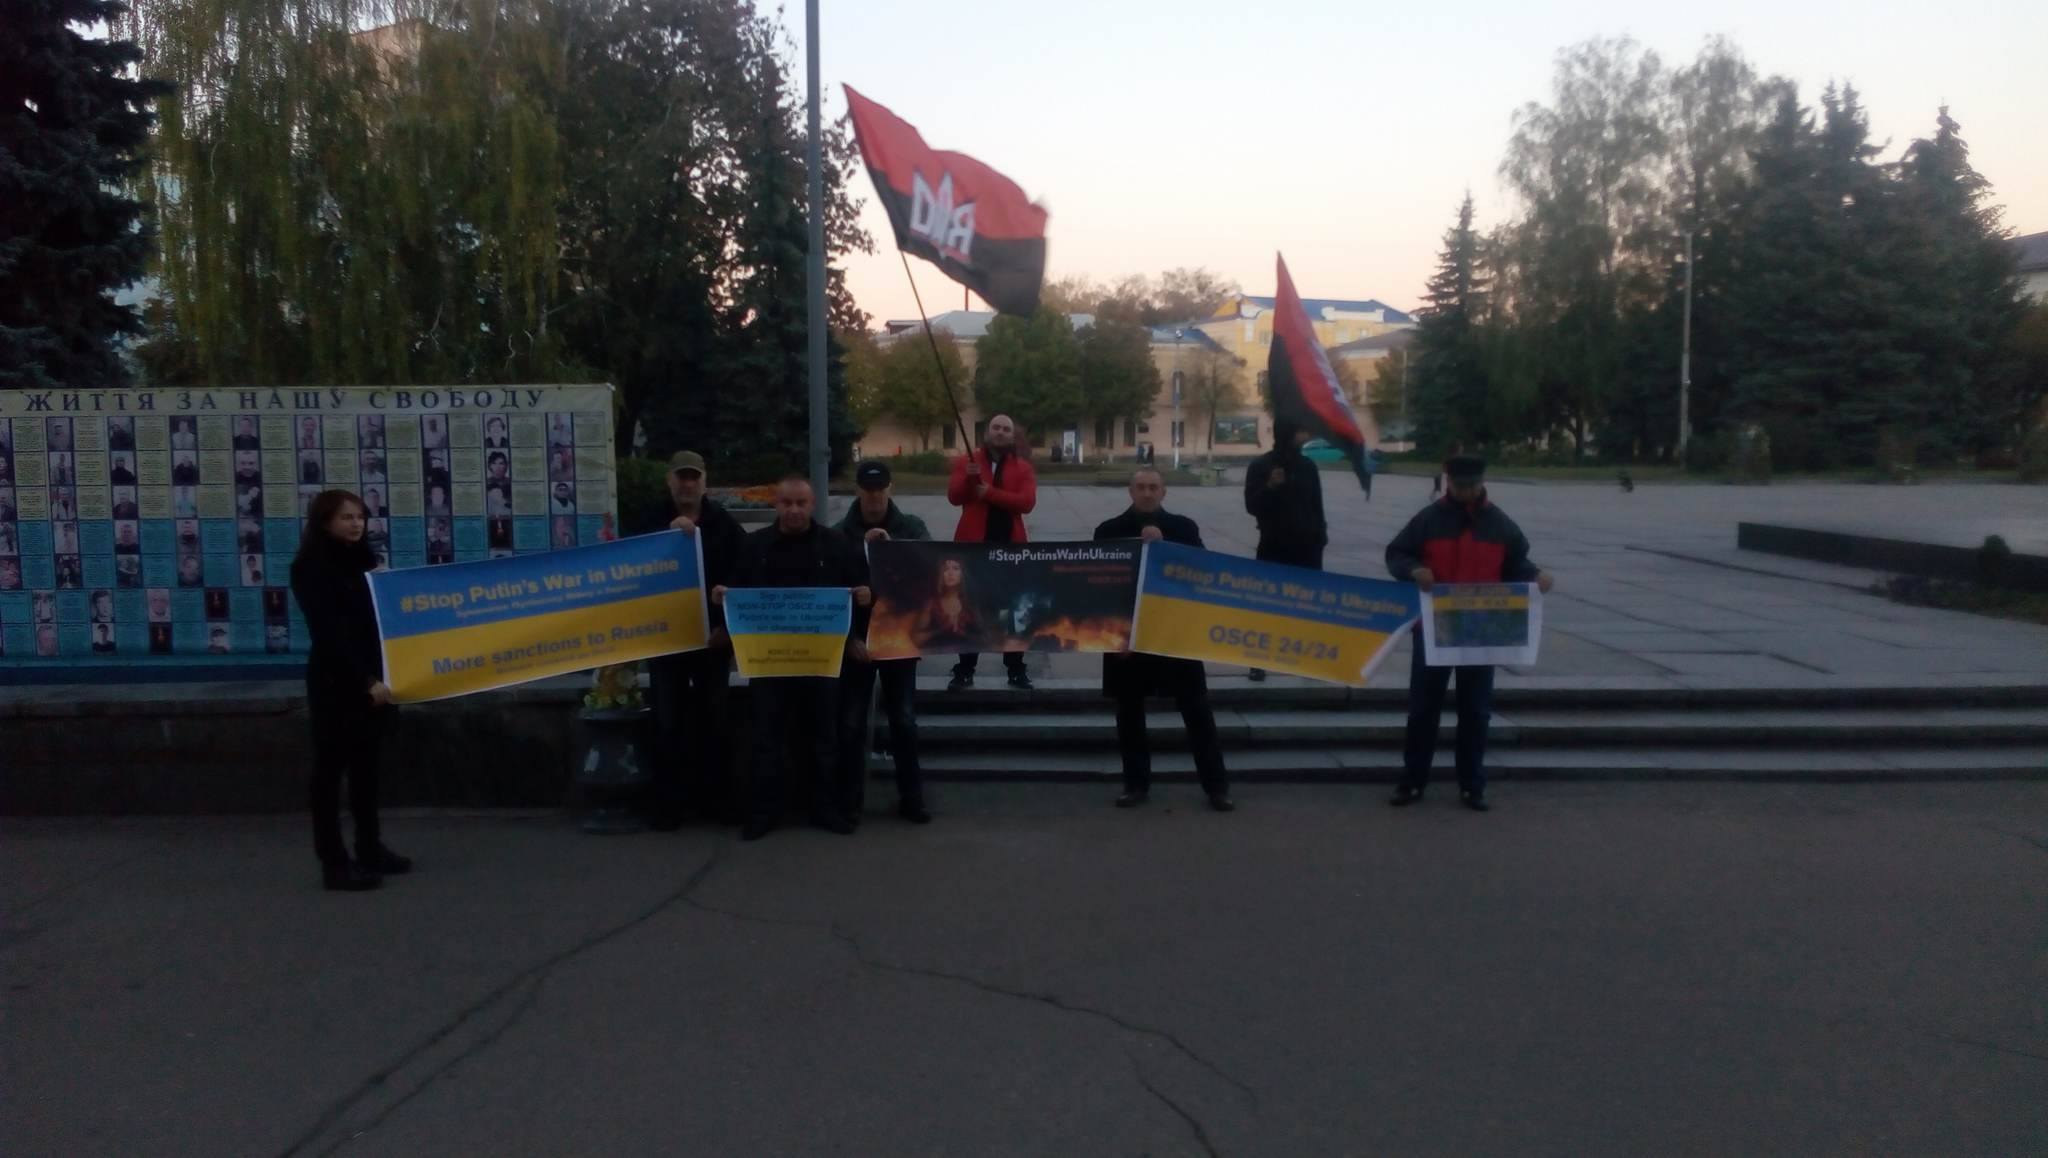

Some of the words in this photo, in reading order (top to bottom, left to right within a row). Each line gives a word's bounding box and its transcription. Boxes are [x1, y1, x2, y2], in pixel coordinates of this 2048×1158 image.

[25, 391, 156, 412] ЖИТТЯ
[176, 391, 217, 411] ЗА
[238, 388, 348, 411] НАШУ
[368, 389, 545, 410] СВОБОДУ
[988, 548, 1133, 565] #StopPutinsWarInUkraine
[401, 590, 465, 614] #Stop
[469, 579, 539, 603] Putin's
[543, 572, 583, 591] War
[588, 568, 606, 583] in
[609, 558, 680, 581] Ukraine
[1219, 570, 1277, 595] Putin's
[1282, 582, 1315, 600] War
[1319, 588, 1336, 604] in
[1341, 592, 1408, 616] Ukraine
[432, 654, 486, 675] More
[491, 635, 582, 665] sanctions
[587, 631, 606, 647] to
[611, 619, 670, 641] Russia
[1209, 624, 1272, 650] OSCE
[1278, 636, 1340, 661] 24/24
